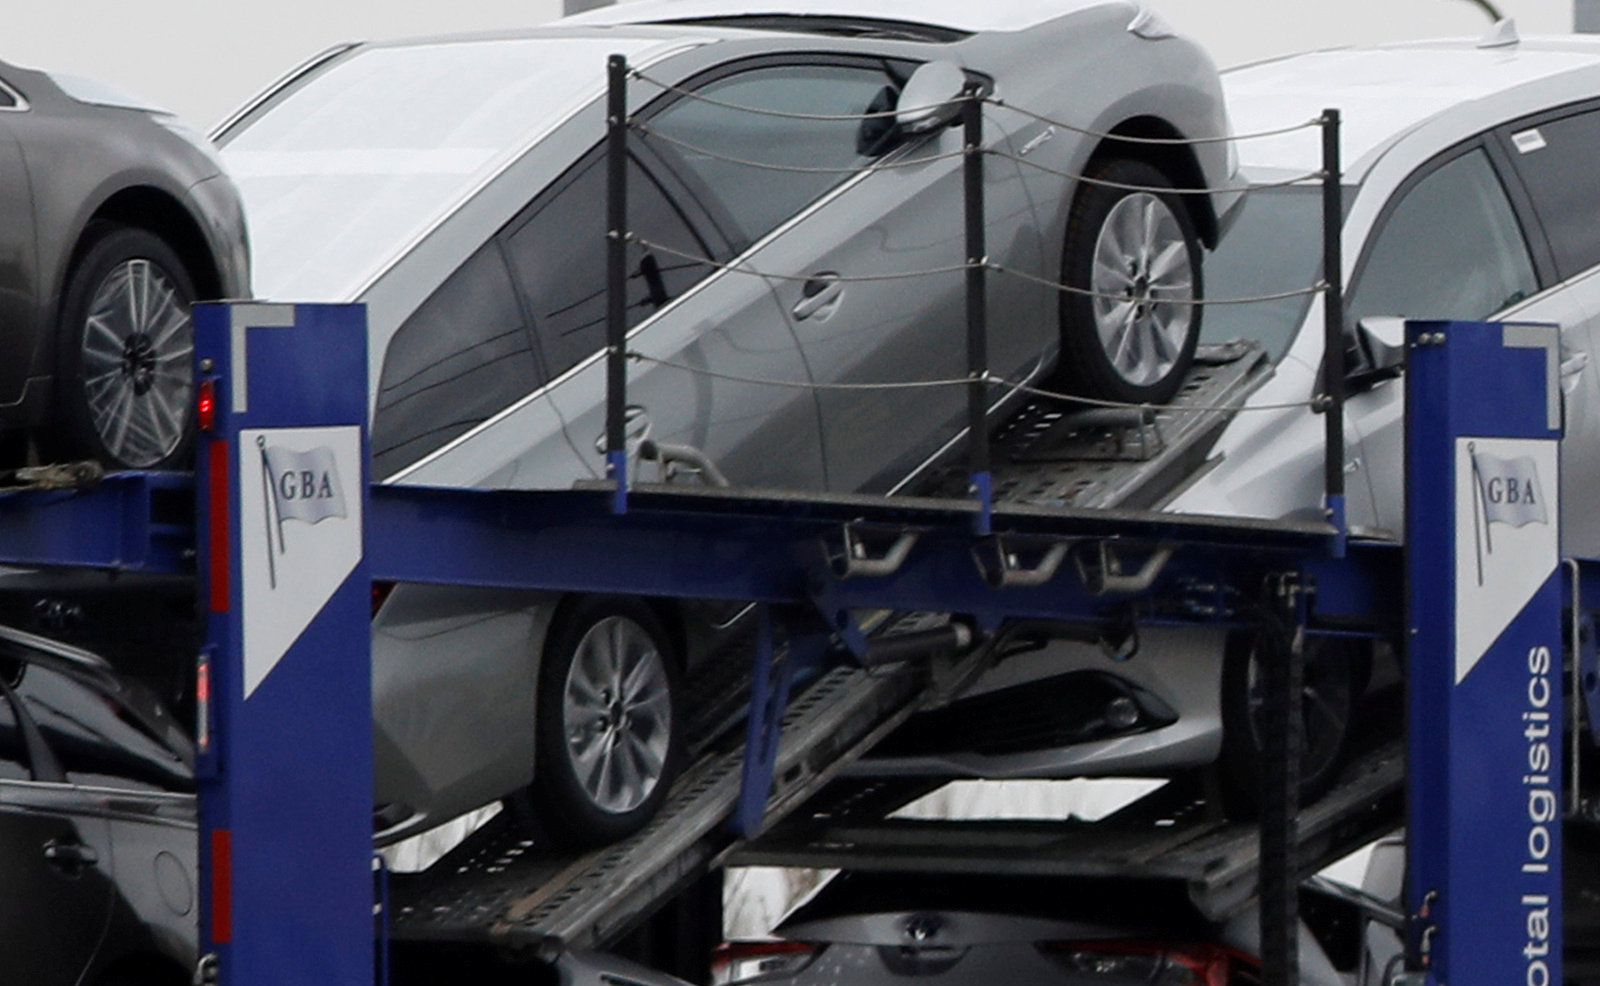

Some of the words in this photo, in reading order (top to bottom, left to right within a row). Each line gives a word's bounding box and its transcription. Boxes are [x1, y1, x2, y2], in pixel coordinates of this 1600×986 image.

[280, 469, 334, 501] GBA
[1488, 476, 1536, 505] GBA
[1522, 646, 1556, 872] logistics
